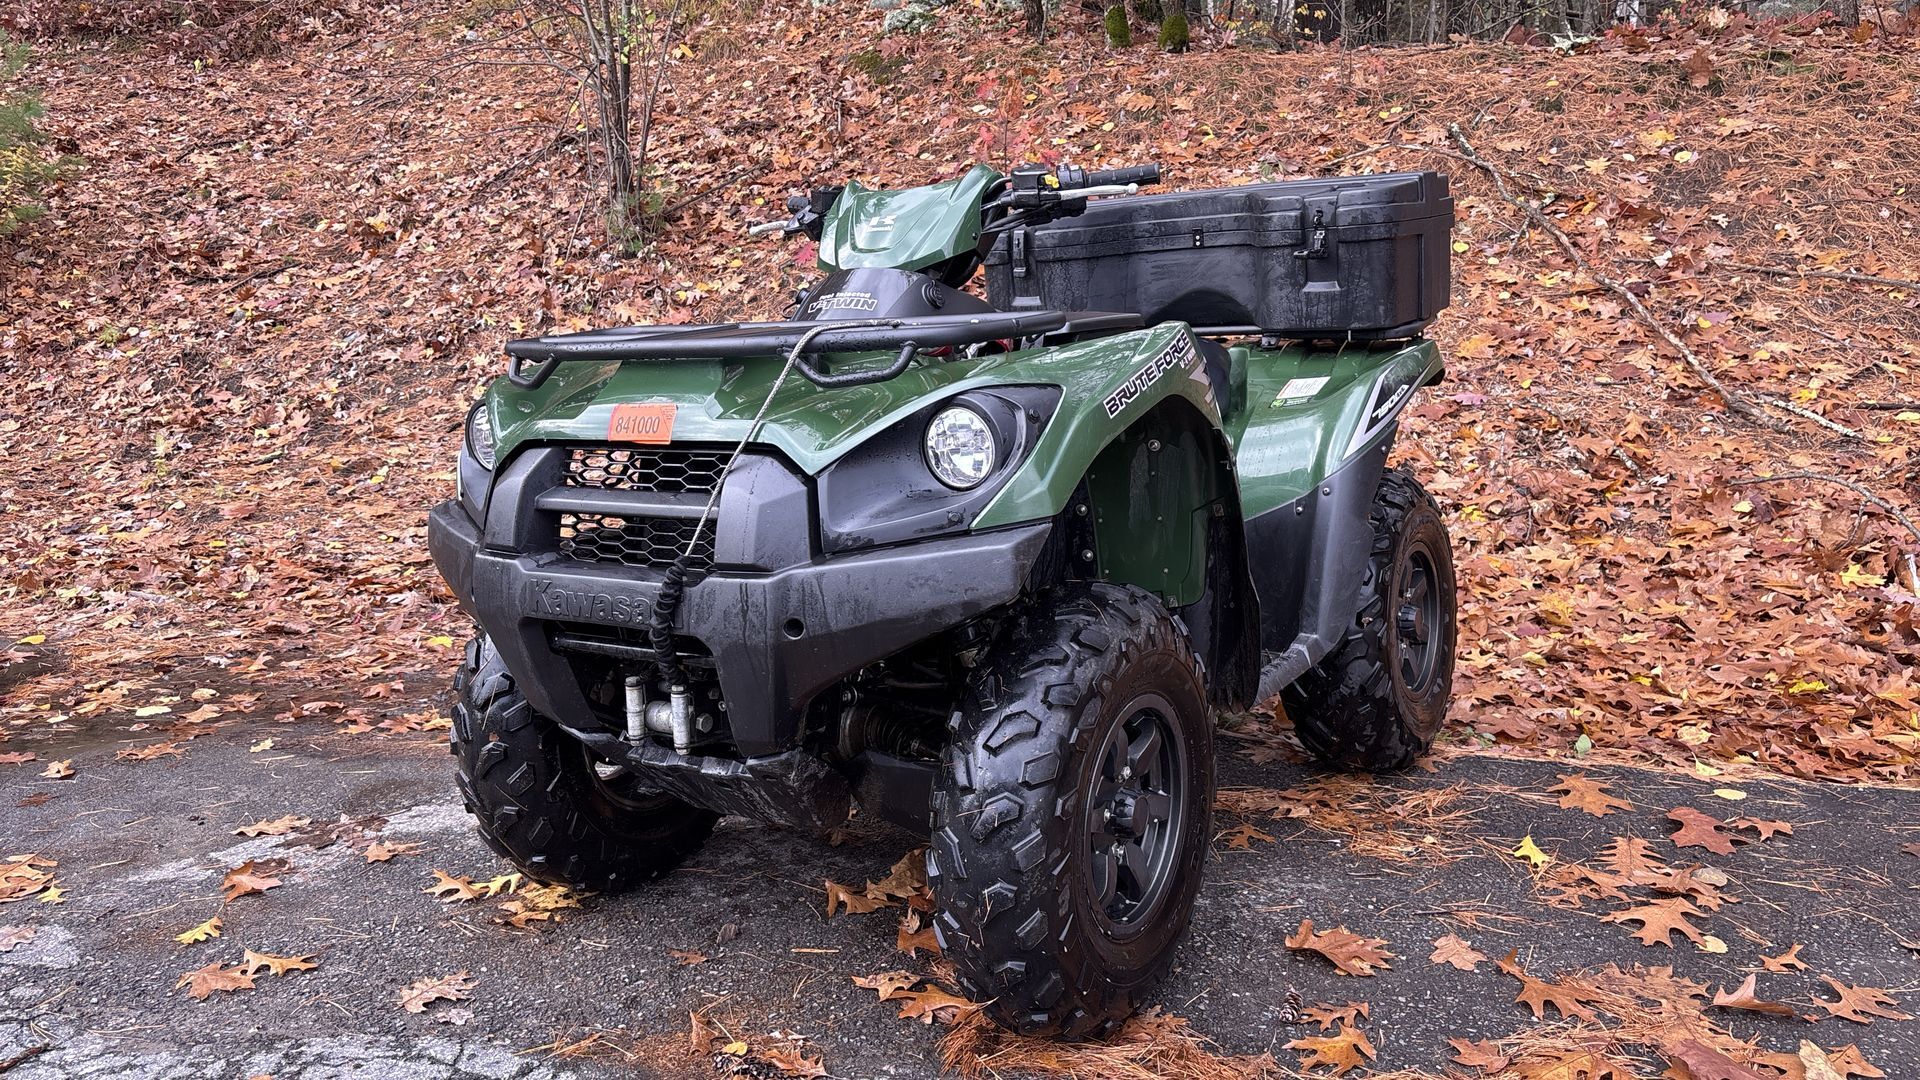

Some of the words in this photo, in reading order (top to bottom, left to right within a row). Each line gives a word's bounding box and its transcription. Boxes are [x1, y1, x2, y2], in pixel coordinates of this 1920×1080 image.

[808, 298, 878, 313] V-TWIN
[1103, 362, 1159, 419] BRUTE
[1153, 329, 1191, 377] FORCE
[1371, 394, 1397, 419] 750
[615, 415, 661, 434] 841000
[526, 578, 684, 629] Kawasai
